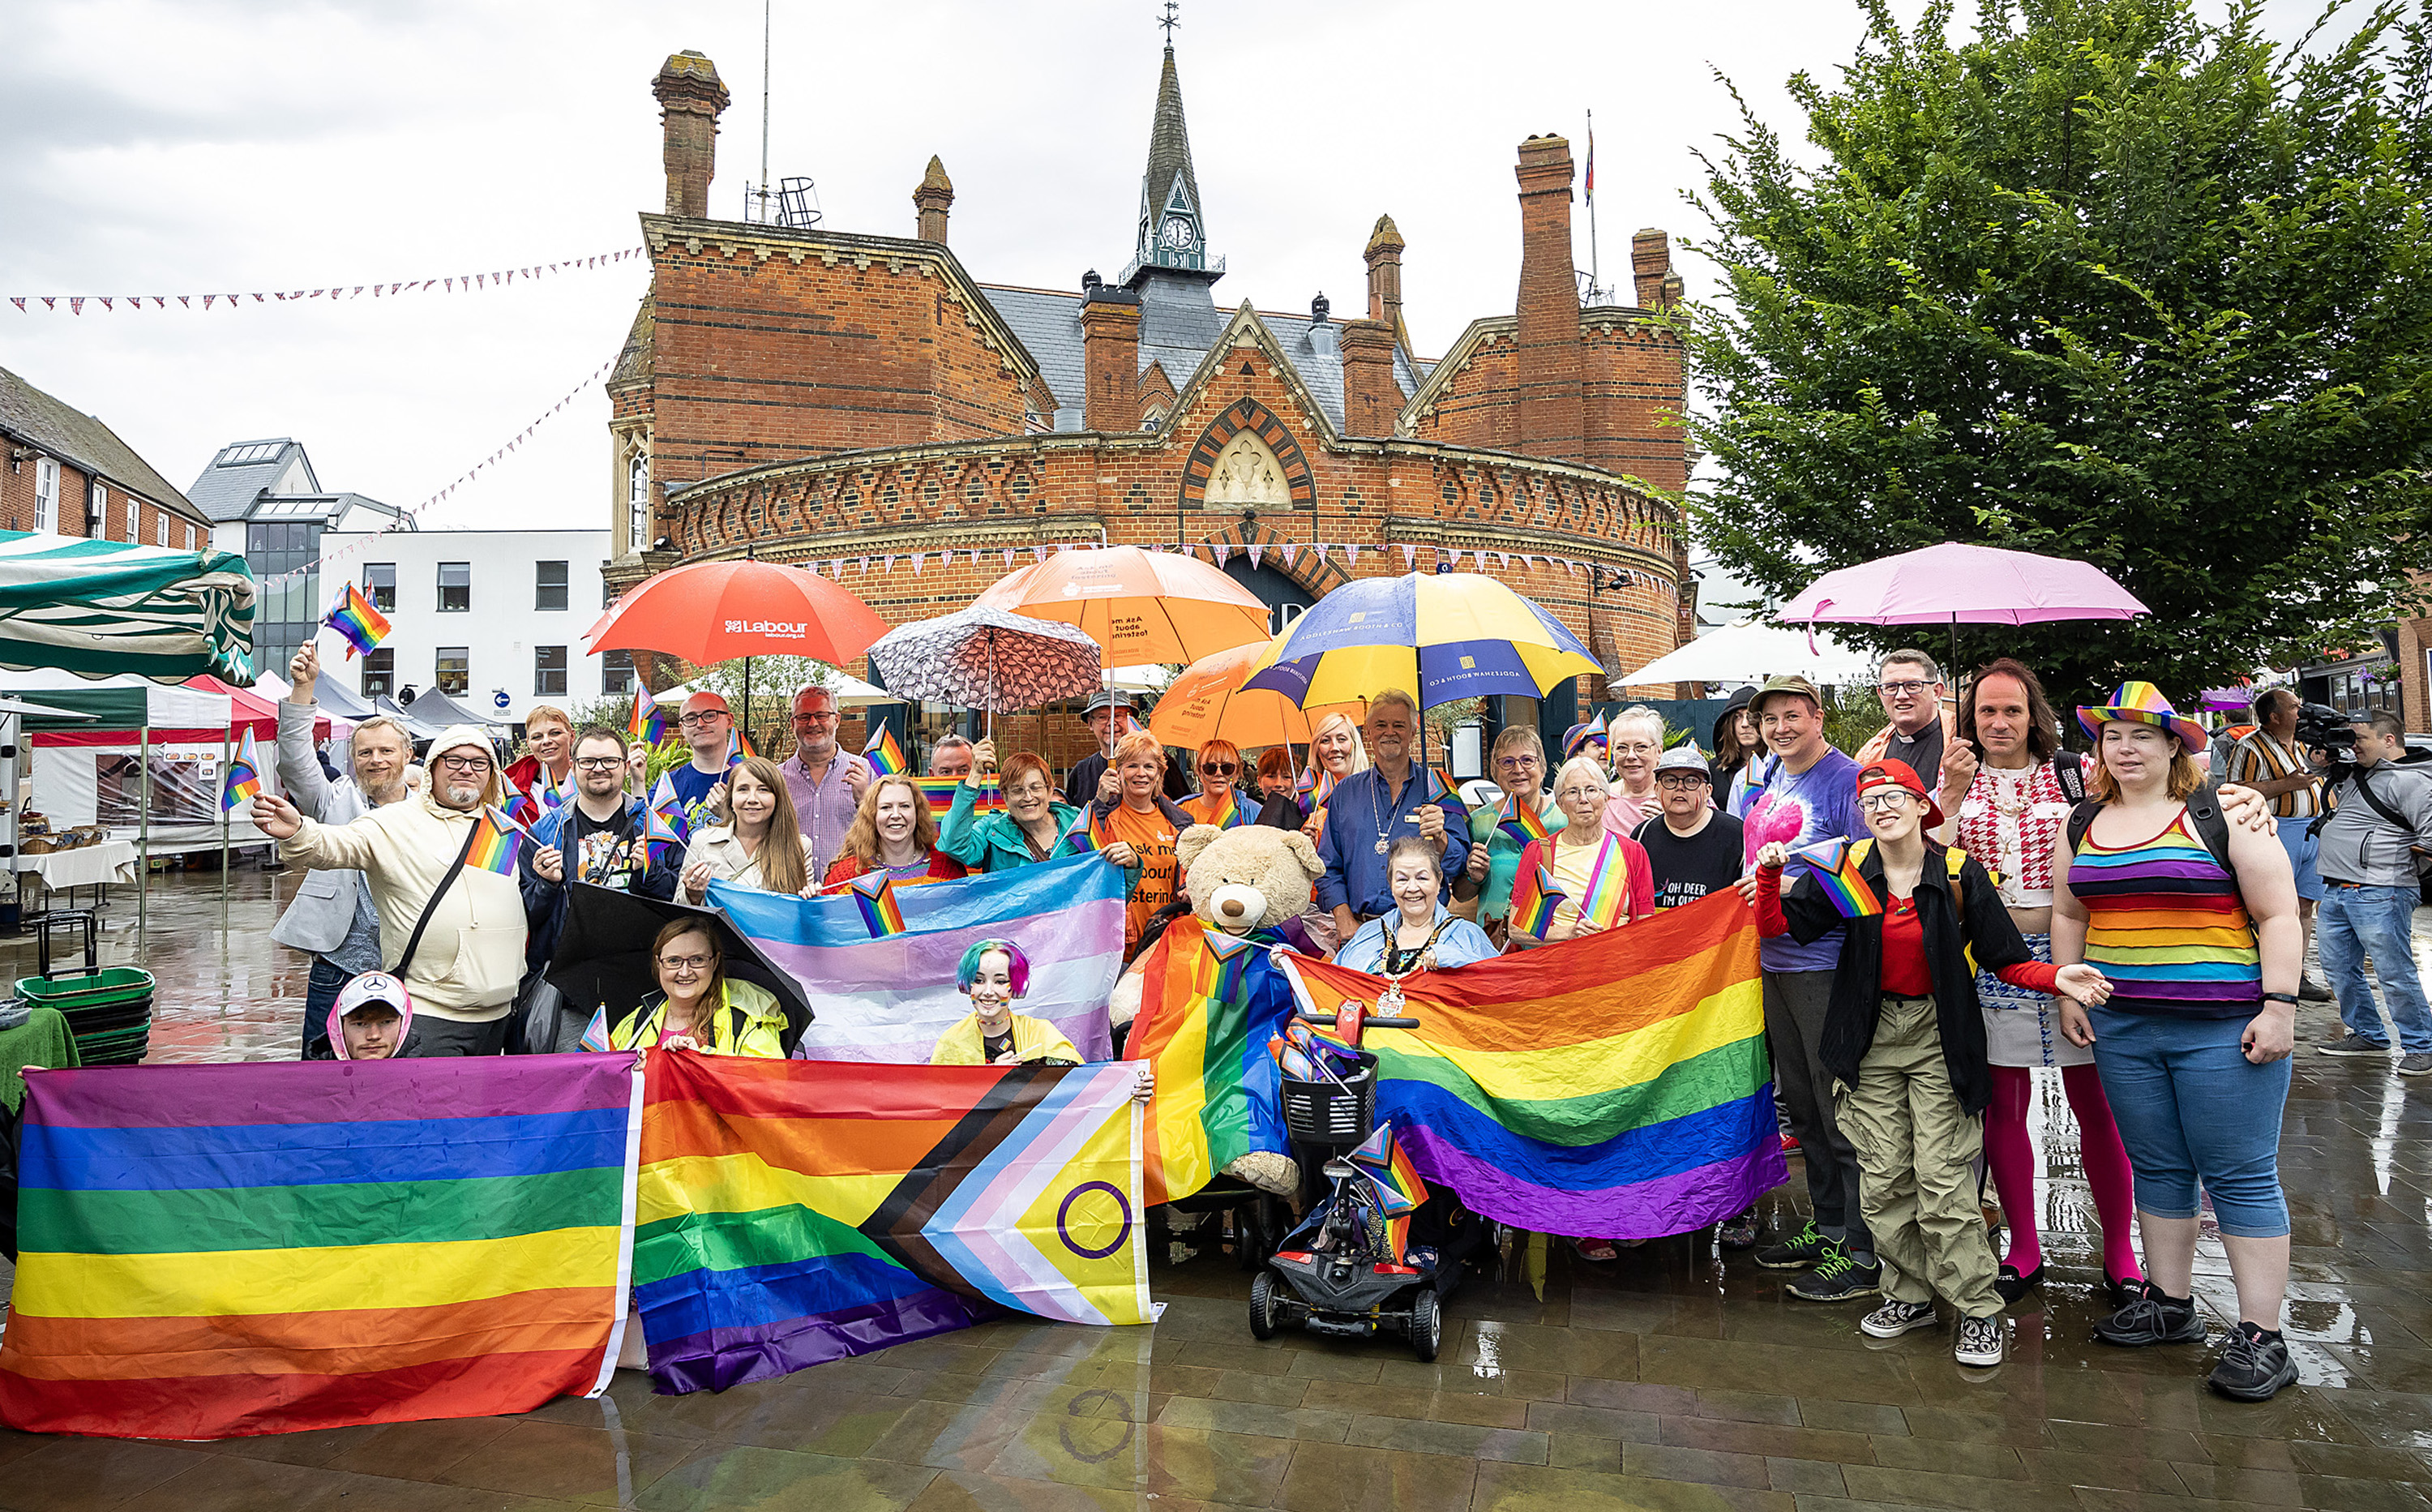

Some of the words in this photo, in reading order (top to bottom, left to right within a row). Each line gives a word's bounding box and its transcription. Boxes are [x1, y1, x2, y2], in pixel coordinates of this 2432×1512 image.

[743, 619, 808, 633] Labour
[1299, 626, 1352, 641] ADDLESHAW
[1136, 842, 1154, 856] sk
[1132, 889, 1175, 903] sterin
[1668, 882, 1682, 893] OH
[1684, 882, 1707, 896] DEER
[1663, 895, 1676, 906] I'M
